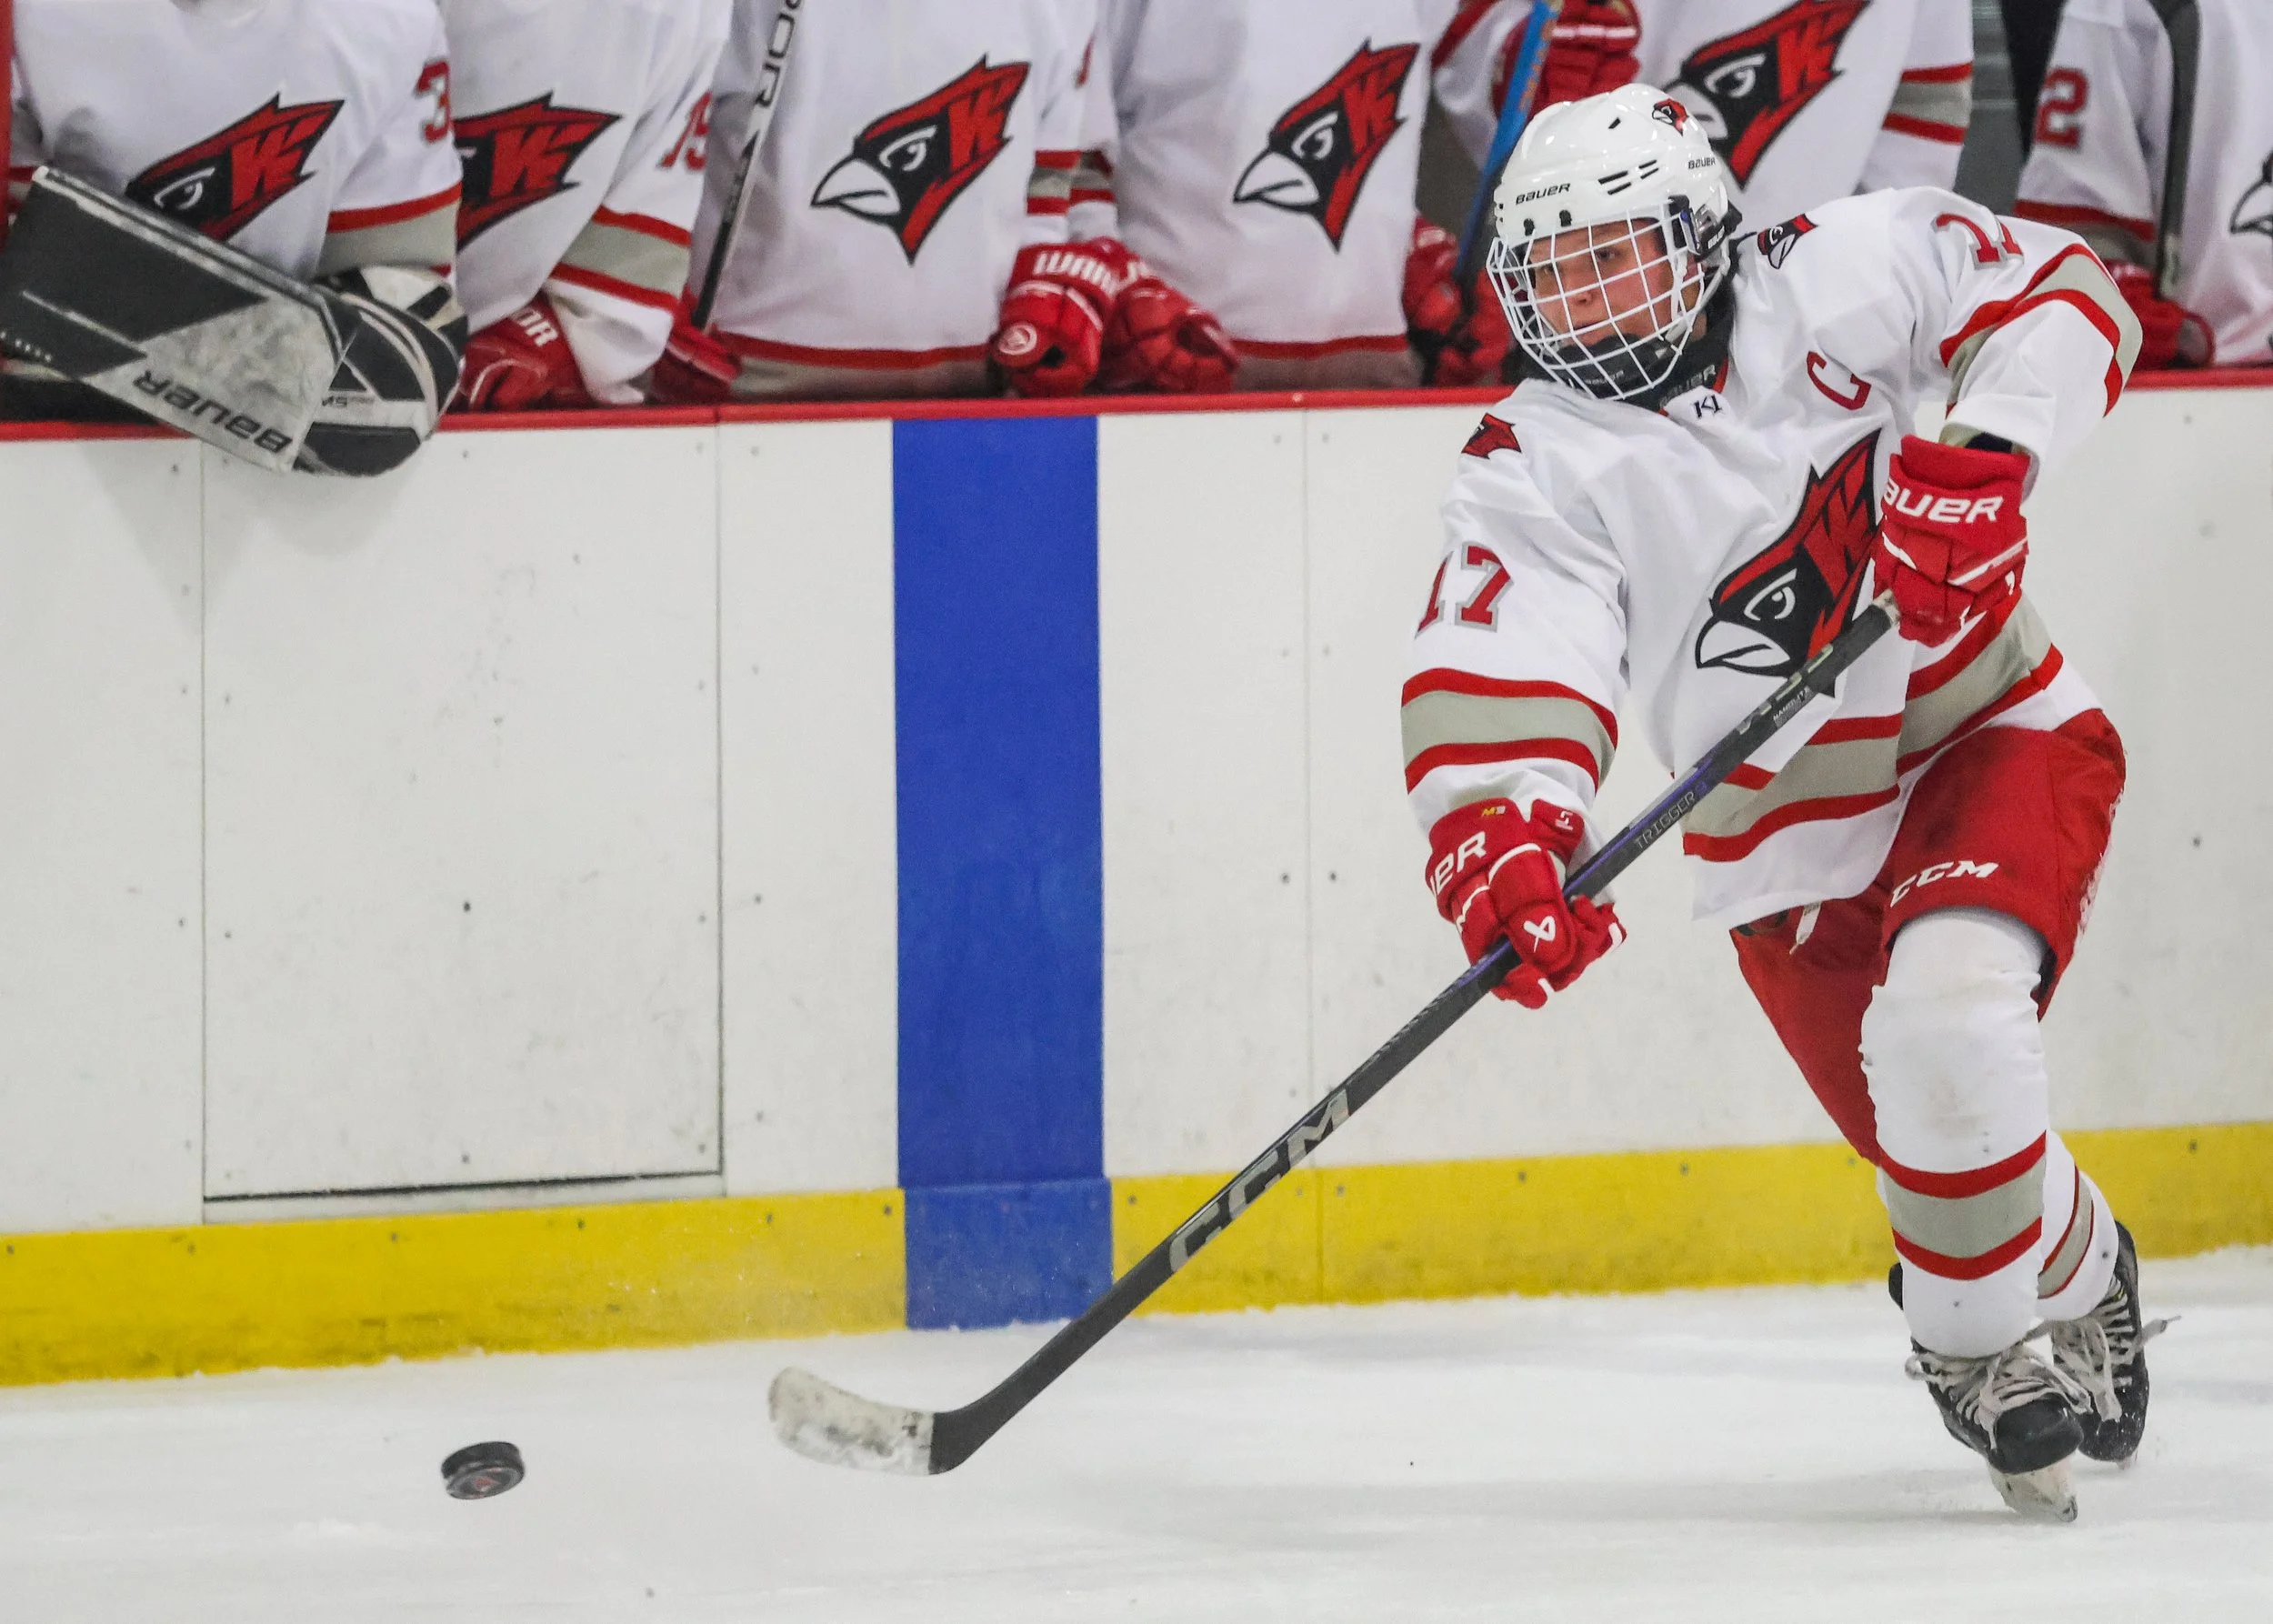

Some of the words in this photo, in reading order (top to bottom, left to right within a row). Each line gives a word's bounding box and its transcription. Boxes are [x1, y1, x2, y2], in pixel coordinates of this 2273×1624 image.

[755, 0, 805, 108] OR
[1687, 155, 1717, 170] BAUER
[1515, 182, 1572, 206] BAUER
[132, 369, 294, 454] BAUER
[1807, 350, 1873, 412] C
[1414, 541, 1516, 641] 17
[1634, 790, 1697, 850] TRIGGER
[1888, 858, 2000, 908] CCM
[1168, 1088, 1351, 1275] CCM
